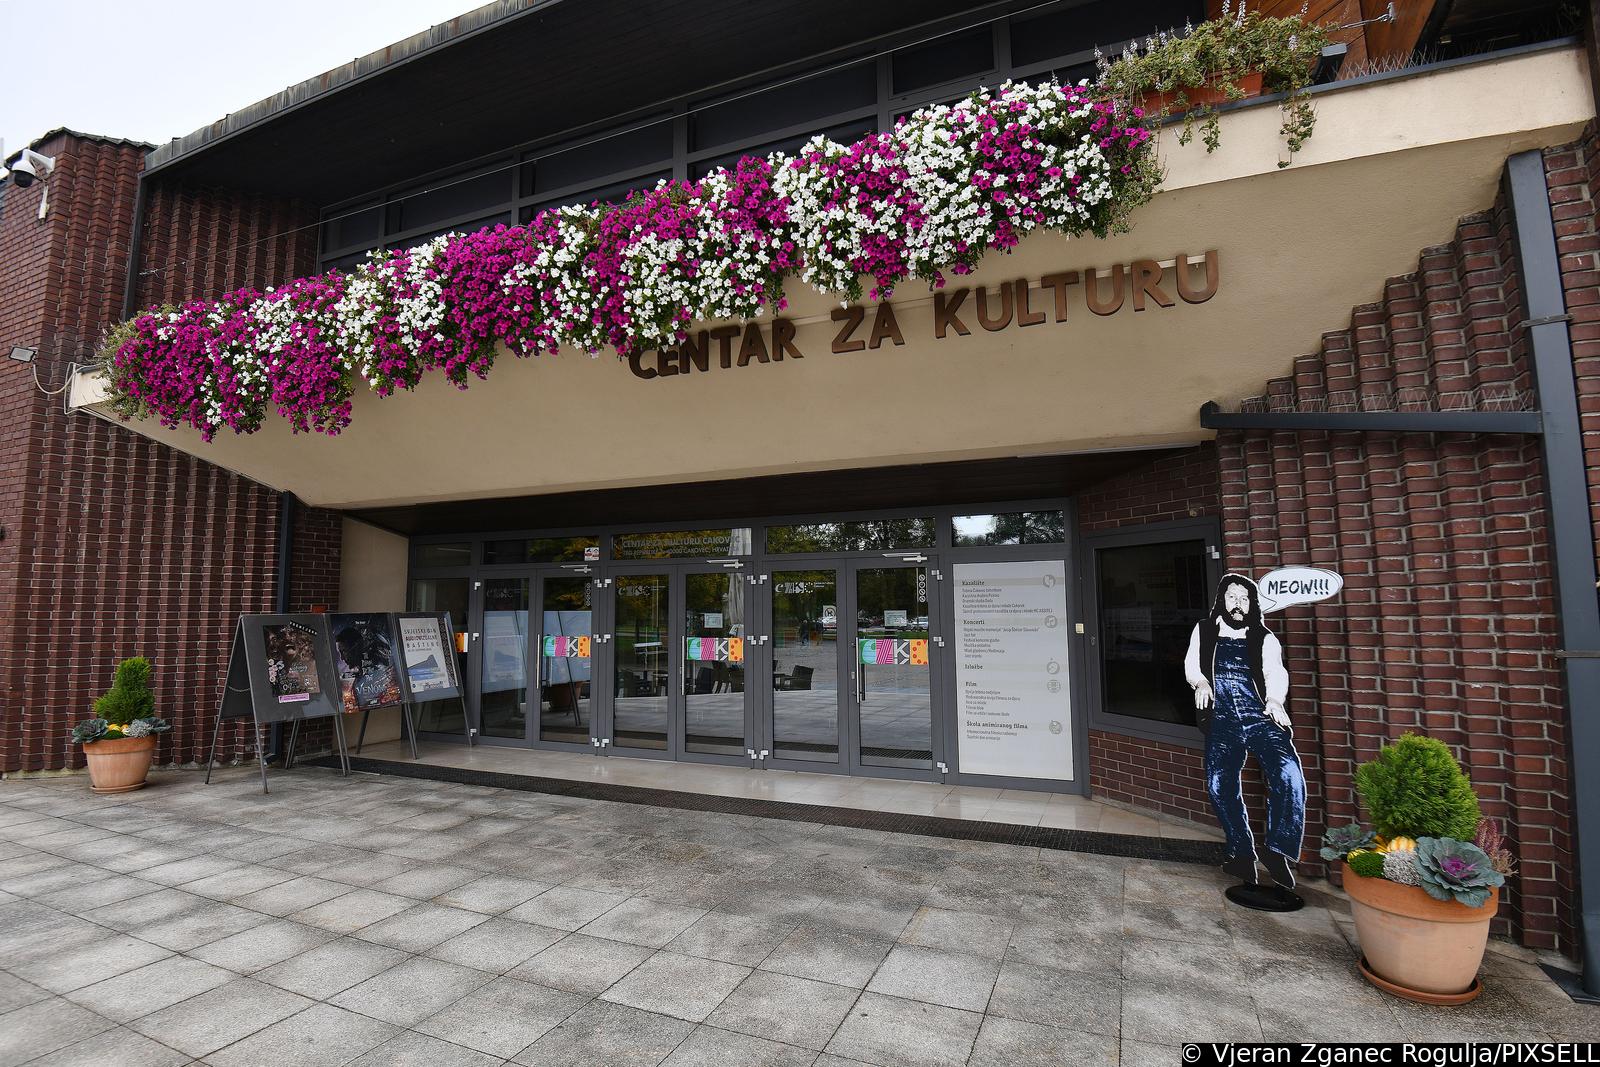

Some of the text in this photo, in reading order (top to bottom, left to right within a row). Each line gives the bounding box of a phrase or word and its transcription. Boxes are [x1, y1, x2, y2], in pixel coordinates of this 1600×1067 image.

[628, 250, 1220, 380] CENTAR ZA KULTURU
[1267, 579, 1329, 595] MEOW!!!
